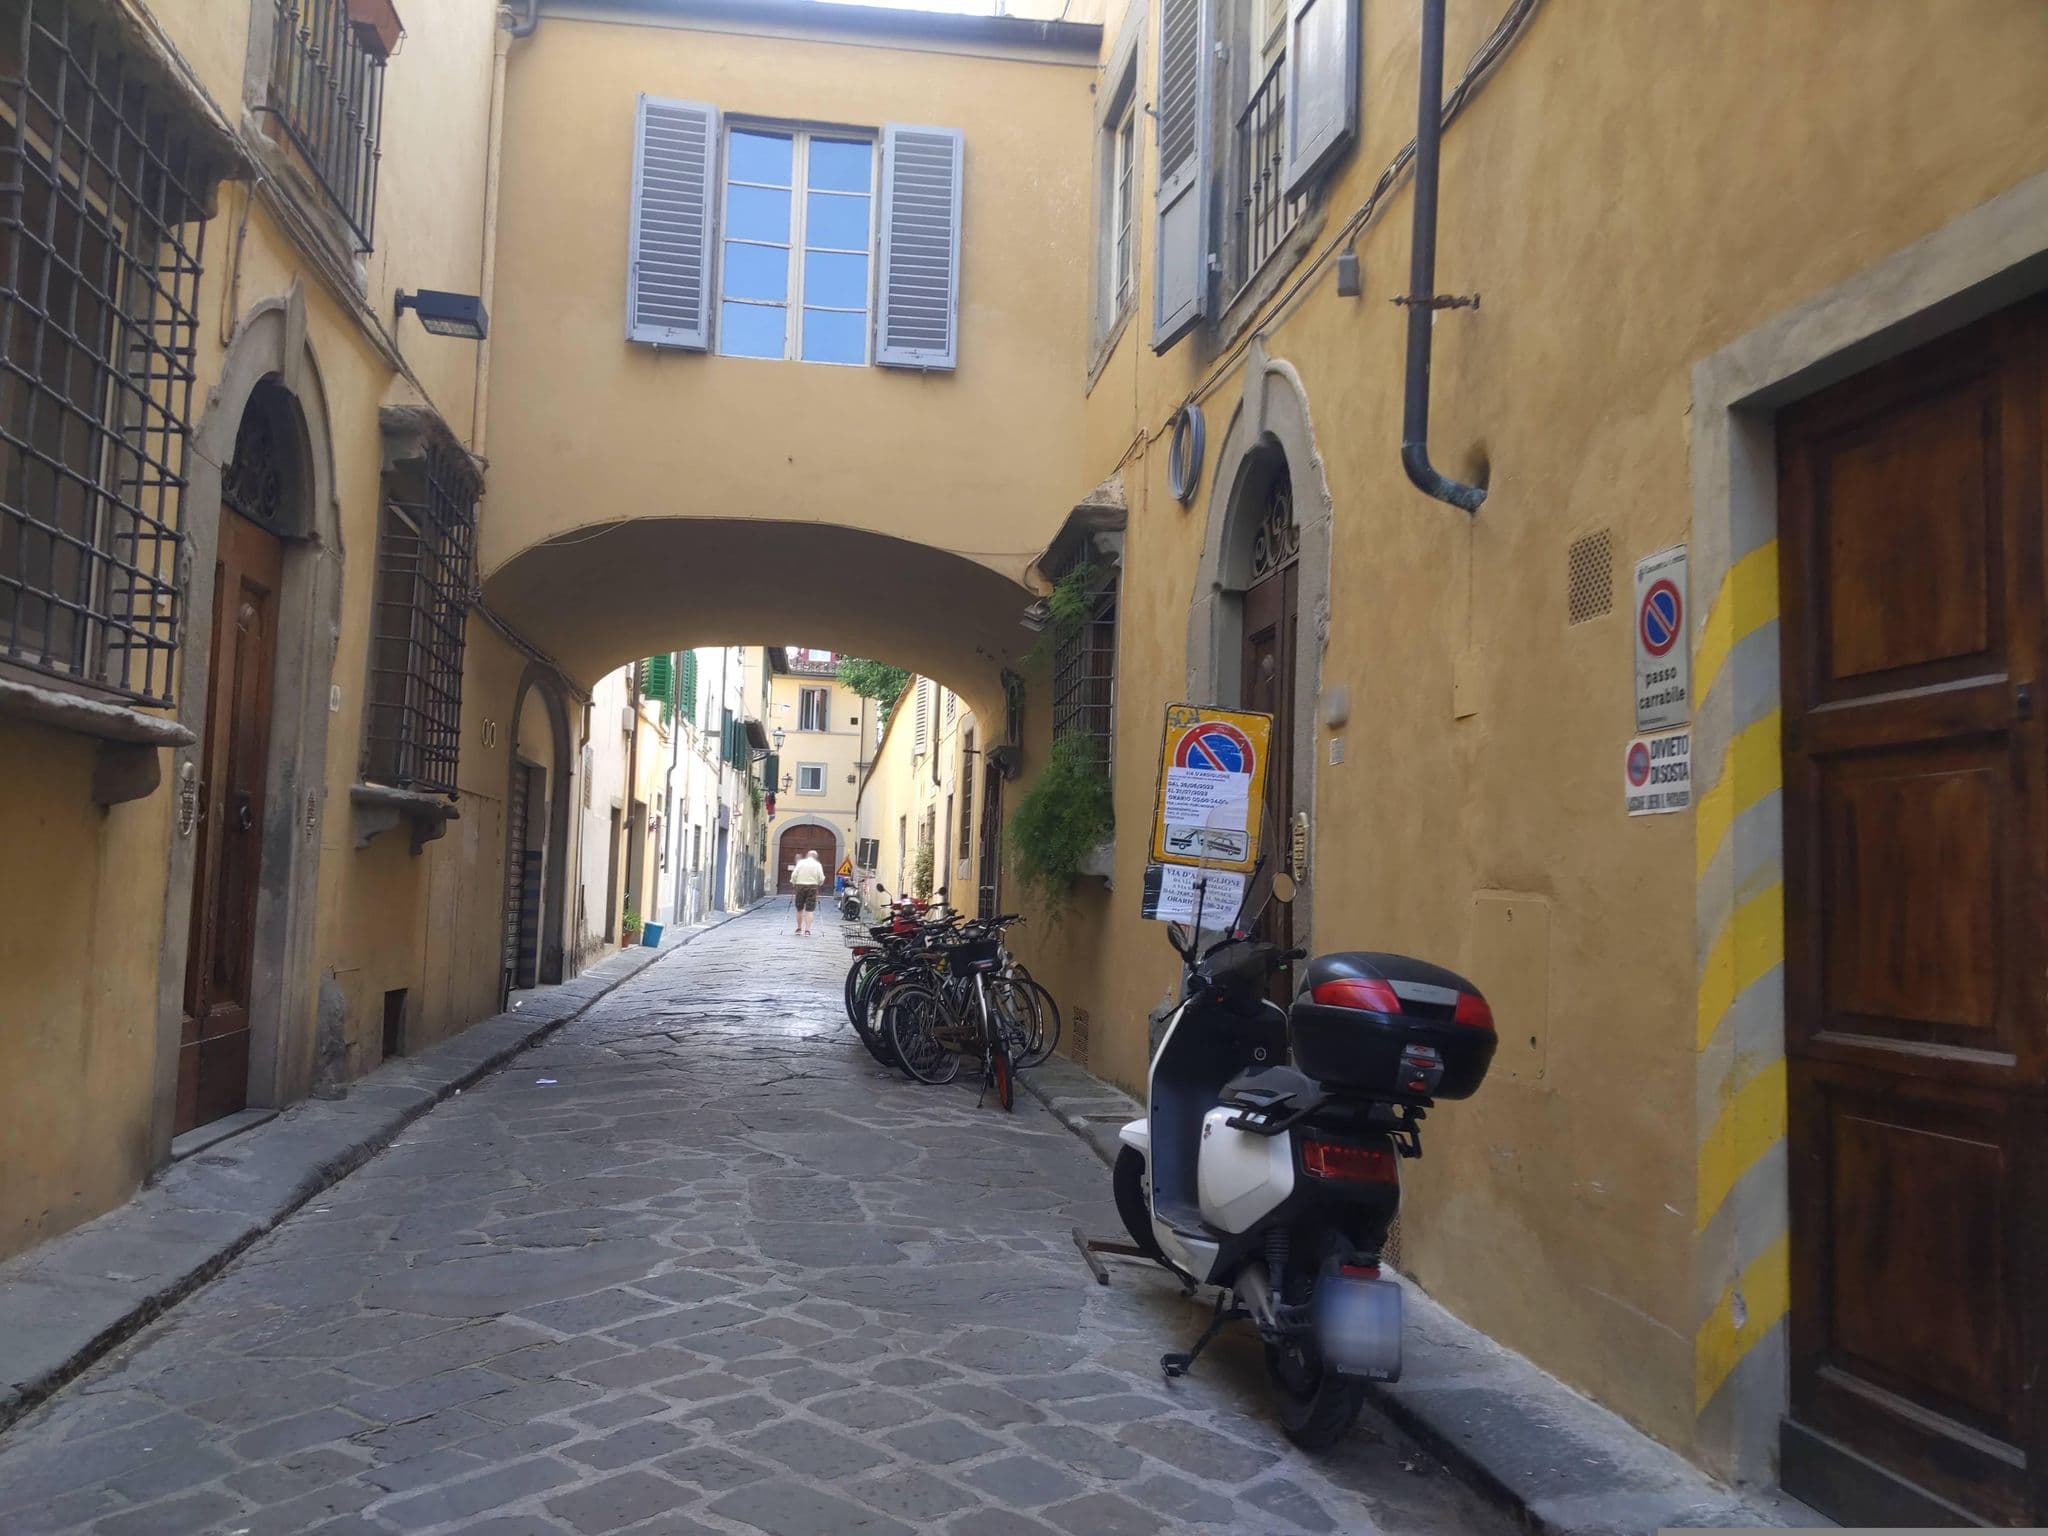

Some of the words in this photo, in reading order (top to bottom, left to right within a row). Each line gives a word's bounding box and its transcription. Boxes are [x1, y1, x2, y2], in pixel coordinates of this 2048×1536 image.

[1645, 666, 1677, 689] passo
[1639, 685, 1686, 710] carrabile
[1650, 735, 1689, 760] DIVIETO
[1661, 762, 1690, 784] SOSTA
[1167, 868, 1181, 877] VIA
